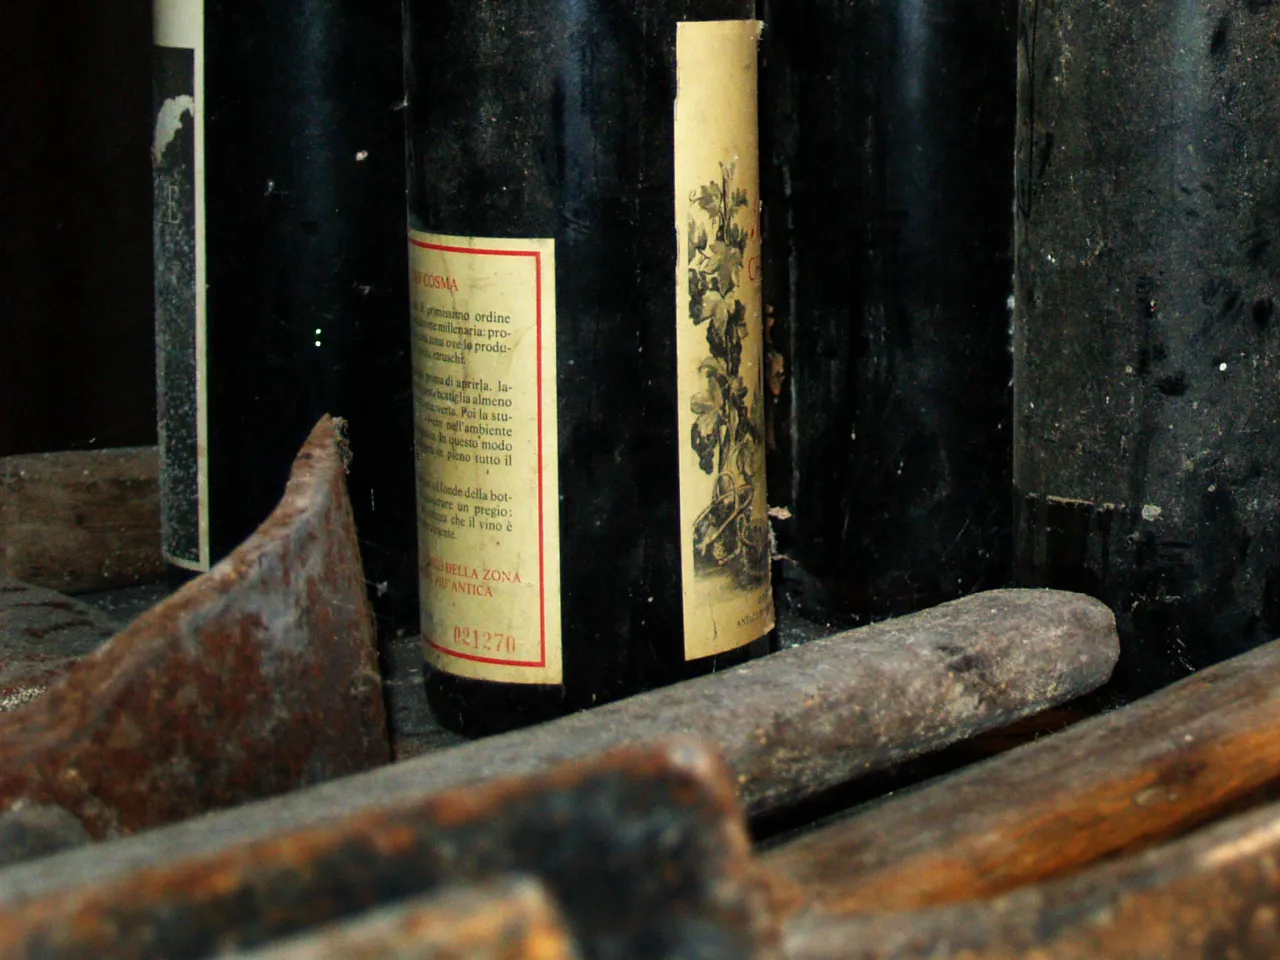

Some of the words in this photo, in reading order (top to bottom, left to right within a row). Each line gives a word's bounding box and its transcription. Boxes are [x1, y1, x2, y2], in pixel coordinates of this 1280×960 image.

[423, 273, 459, 292] COSMA
[427, 307, 470, 321] primissimo
[474, 310, 511, 324] ordine
[437, 322, 486, 337] millenaria:
[487, 329, 511, 340] pro-
[445, 339, 461, 349] ove
[463, 339, 473, 351] lo
[474, 341, 512, 354] produ-
[498, 380, 513, 392] la-
[472, 394, 513, 407] almeno
[461, 407, 477, 420] Poi
[479, 408, 488, 420] la
[491, 412, 513, 422] stu-
[446, 420, 513, 437] nell'ambiente
[449, 437, 479, 450] questo
[481, 439, 513, 452] modo
[447, 450, 471, 462] pieno
[475, 453, 501, 465] tutto
[504, 454, 513, 467] il
[464, 486, 489, 500] della
[490, 489, 513, 502] bot-
[457, 503, 469, 513] un
[451, 514, 466, 527] che
[468, 516, 476, 529] il
[479, 520, 503, 531] vino
[506, 520, 513, 532] è
[445, 562, 478, 580] DELLA
[482, 569, 522, 583] ZONA
[451, 580, 494, 598] ANTICA
